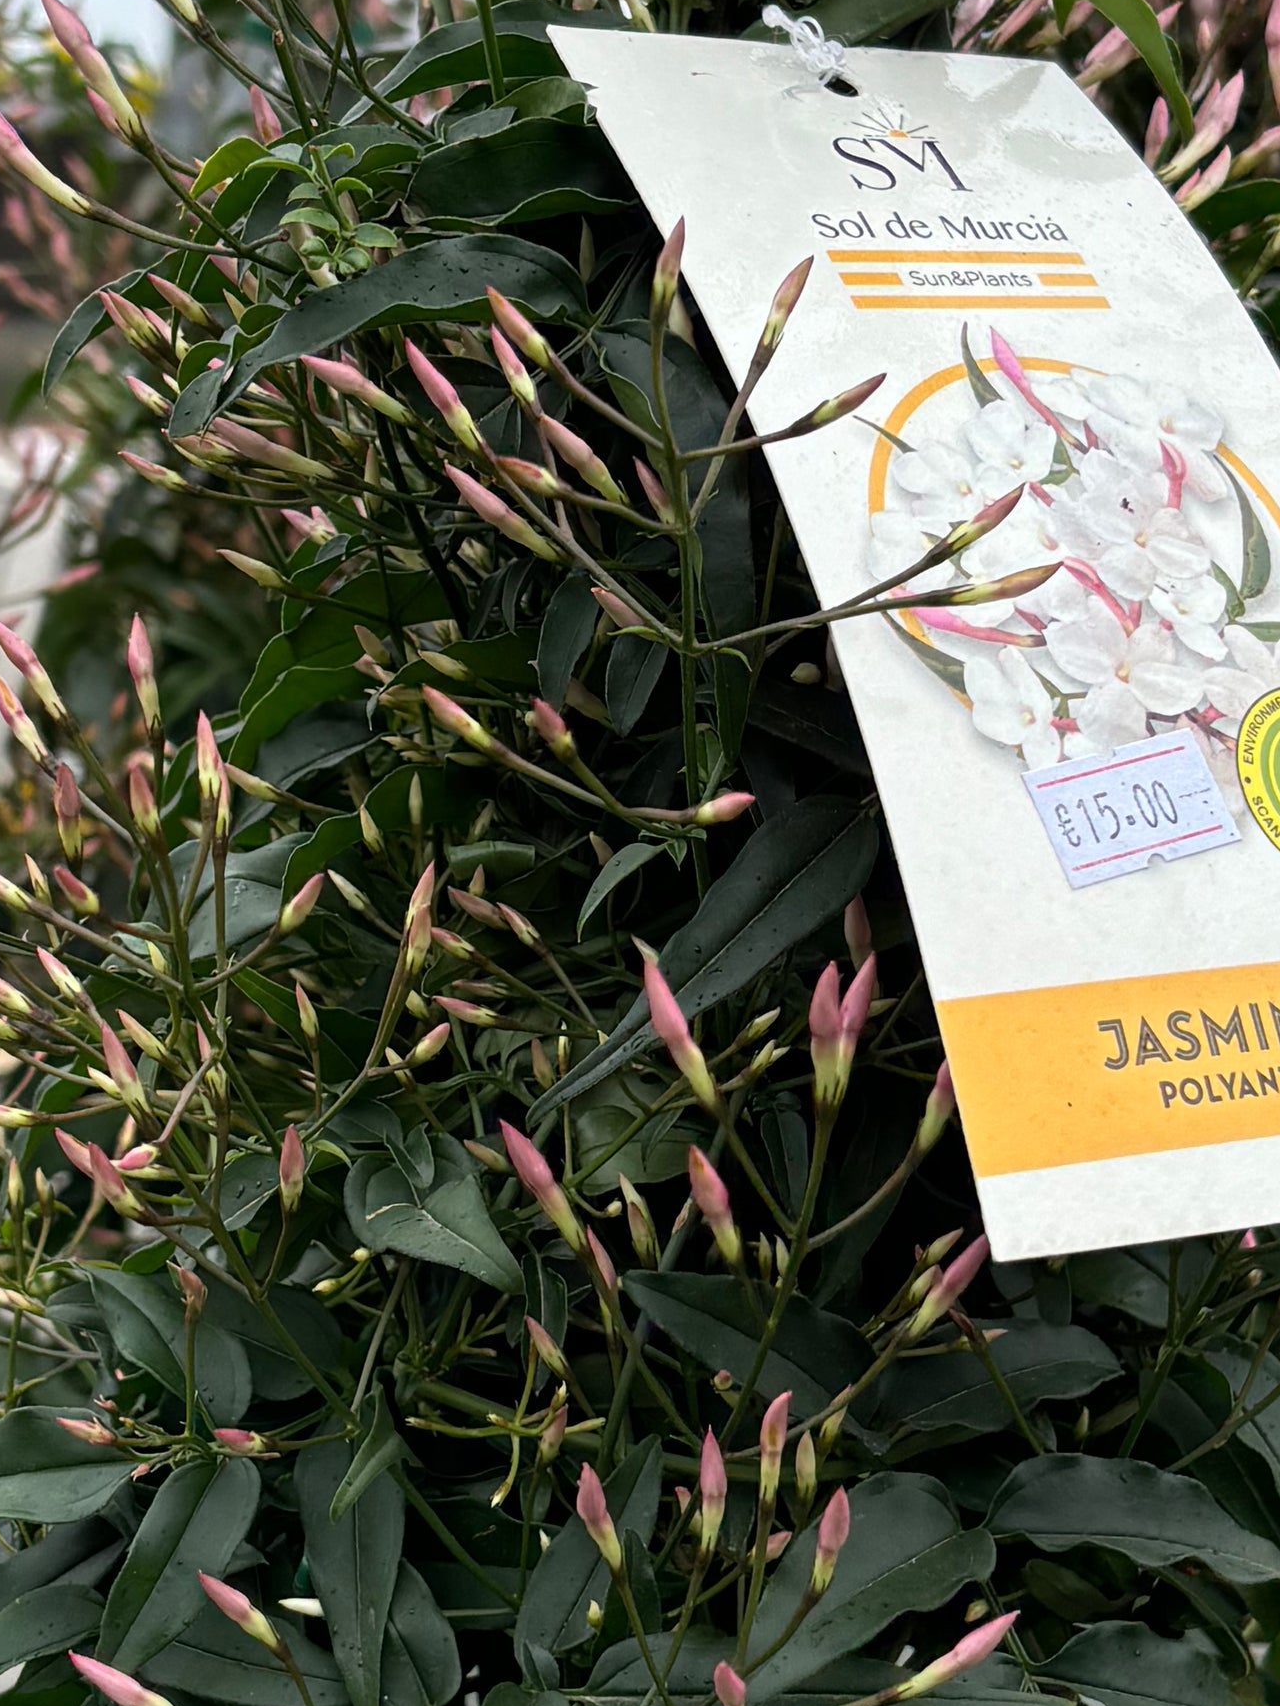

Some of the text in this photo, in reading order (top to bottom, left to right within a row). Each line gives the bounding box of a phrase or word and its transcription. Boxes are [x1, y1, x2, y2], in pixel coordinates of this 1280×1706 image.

[811, 211, 874, 239] Sol
[885, 211, 933, 239] de
[909, 270, 1033, 288] Sun&Plants
[1054, 780, 1178, 847] £15.00
